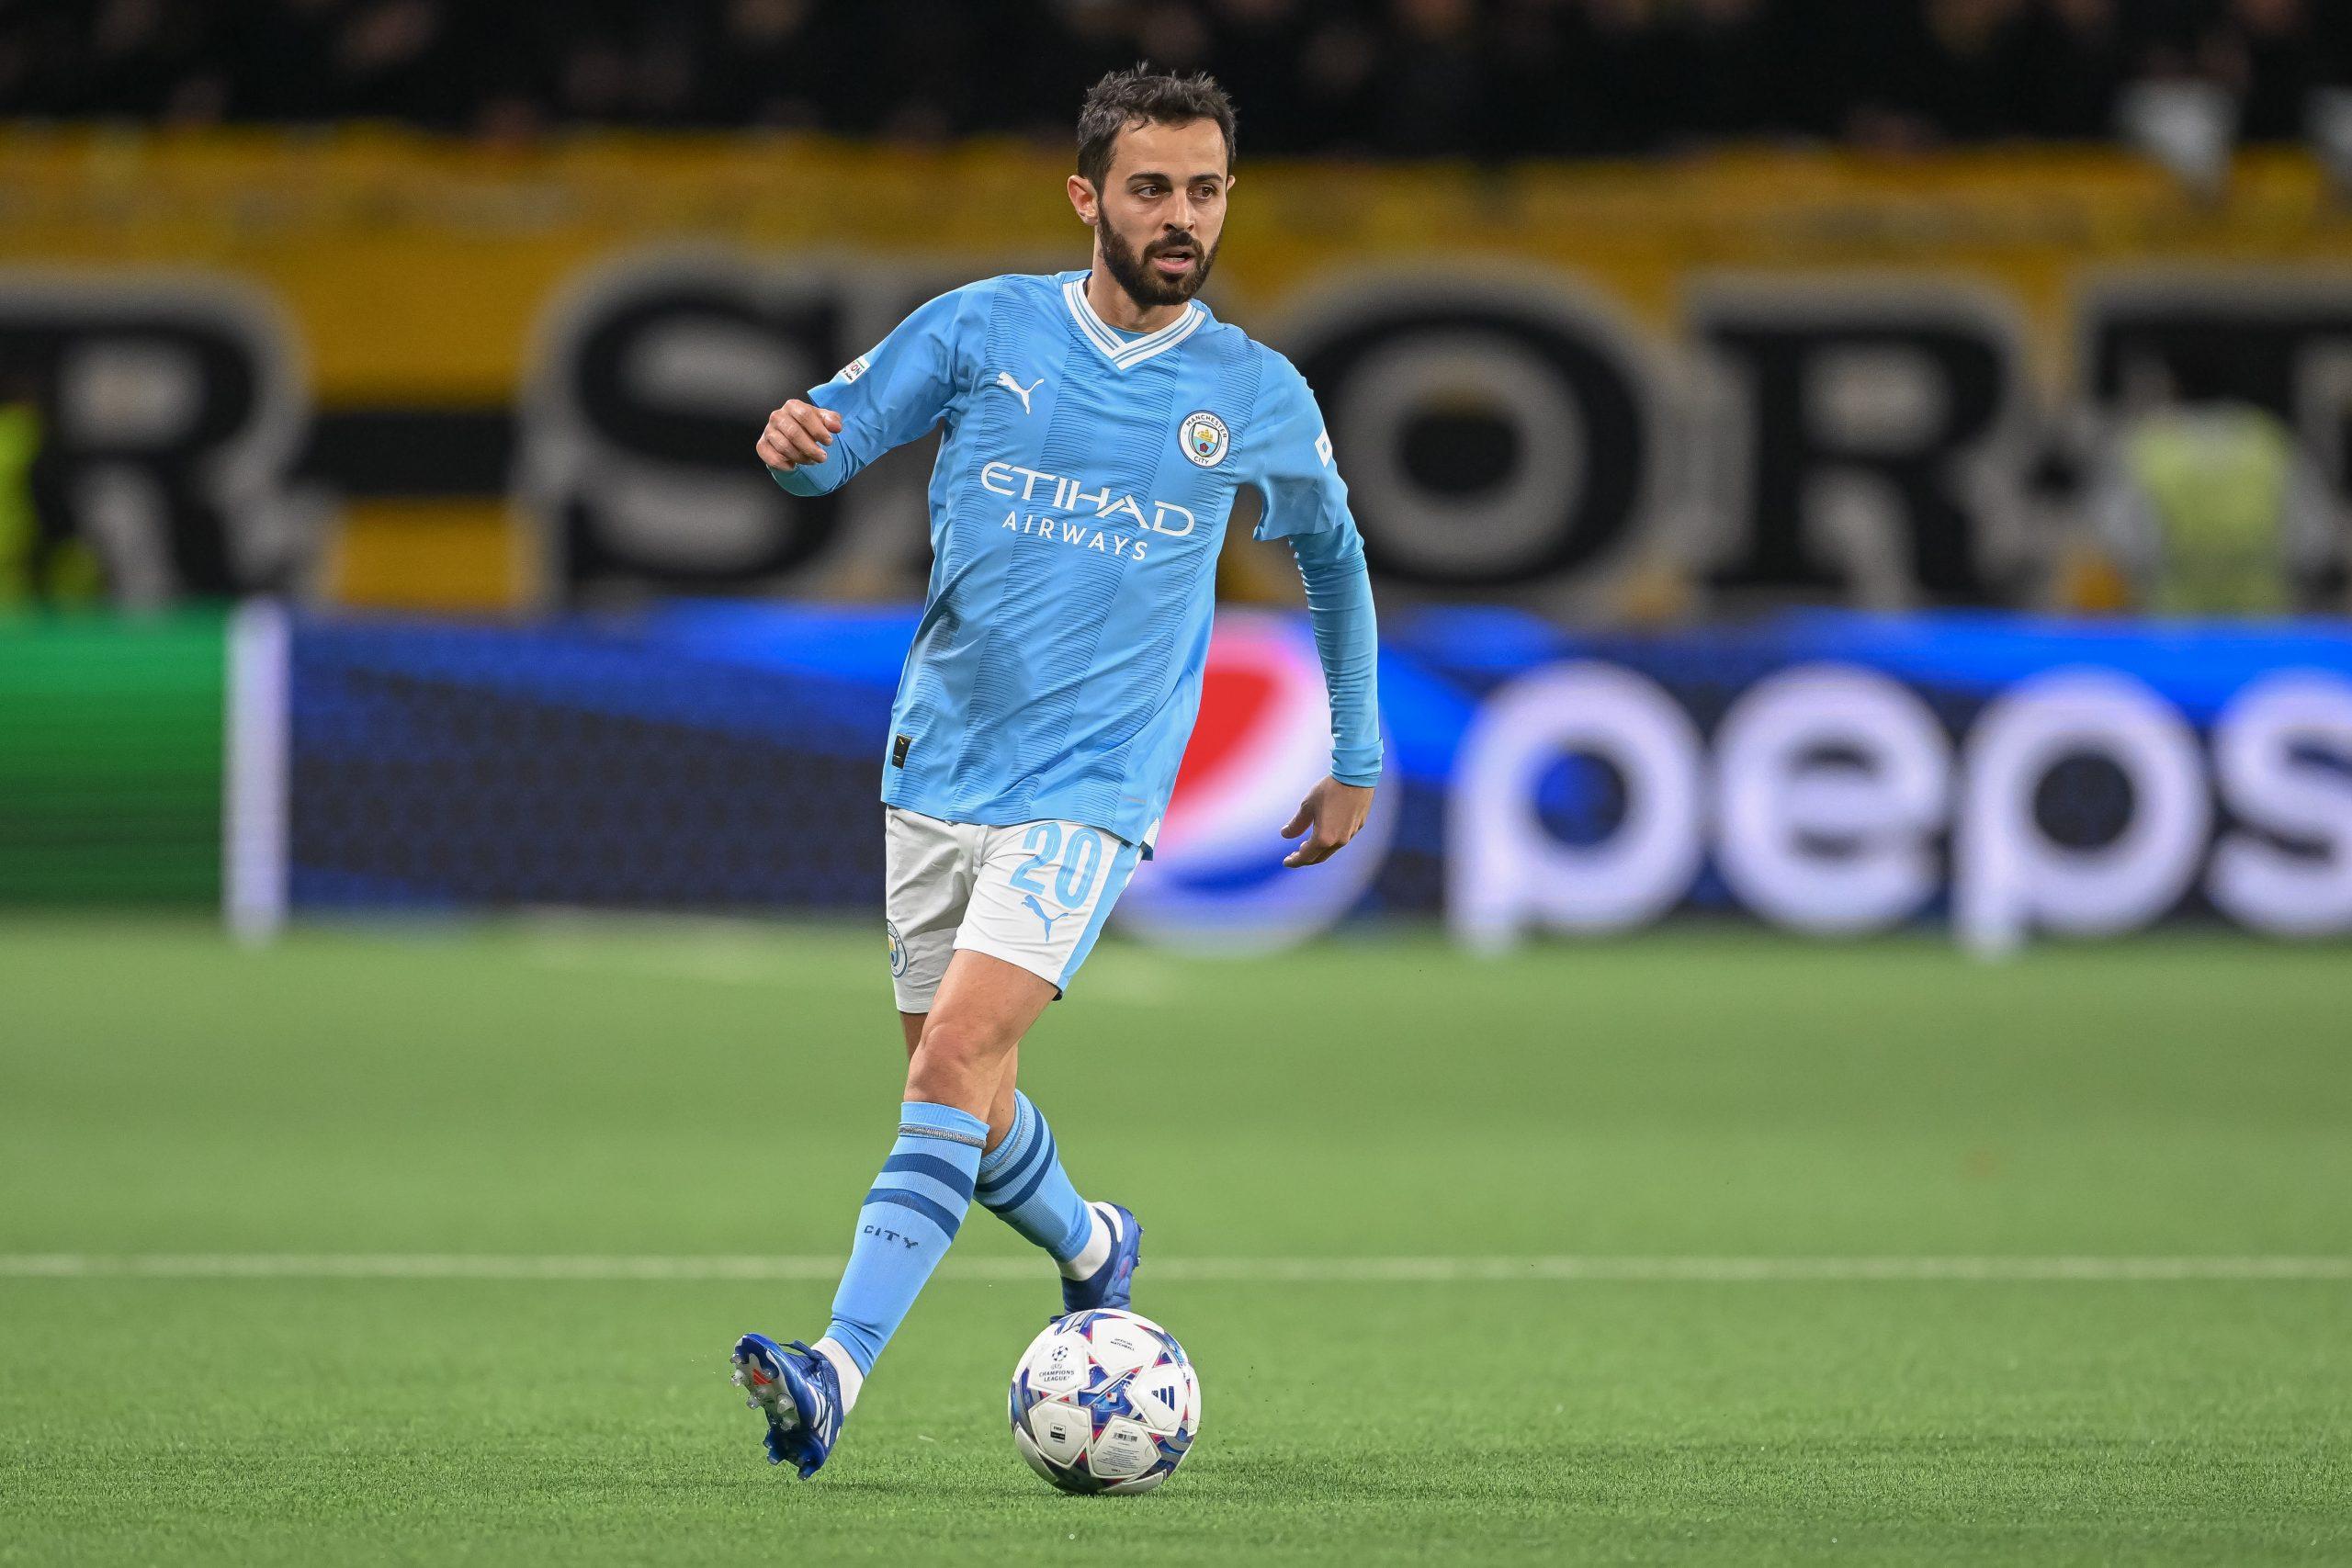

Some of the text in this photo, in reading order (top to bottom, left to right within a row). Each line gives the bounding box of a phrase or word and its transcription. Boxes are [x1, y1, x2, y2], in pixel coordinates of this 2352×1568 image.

[1185, 414, 1227, 438] MANCHESTER
[1193, 456, 1210, 465] CITY
[980, 461, 1195, 536] ETIHAD
[1001, 511, 1148, 560] AIRWAYS
[1009, 822, 1103, 909] 20
[864, 1224, 919, 1249] CITY
[1038, 1370, 1075, 1378] CHAMPIONS
